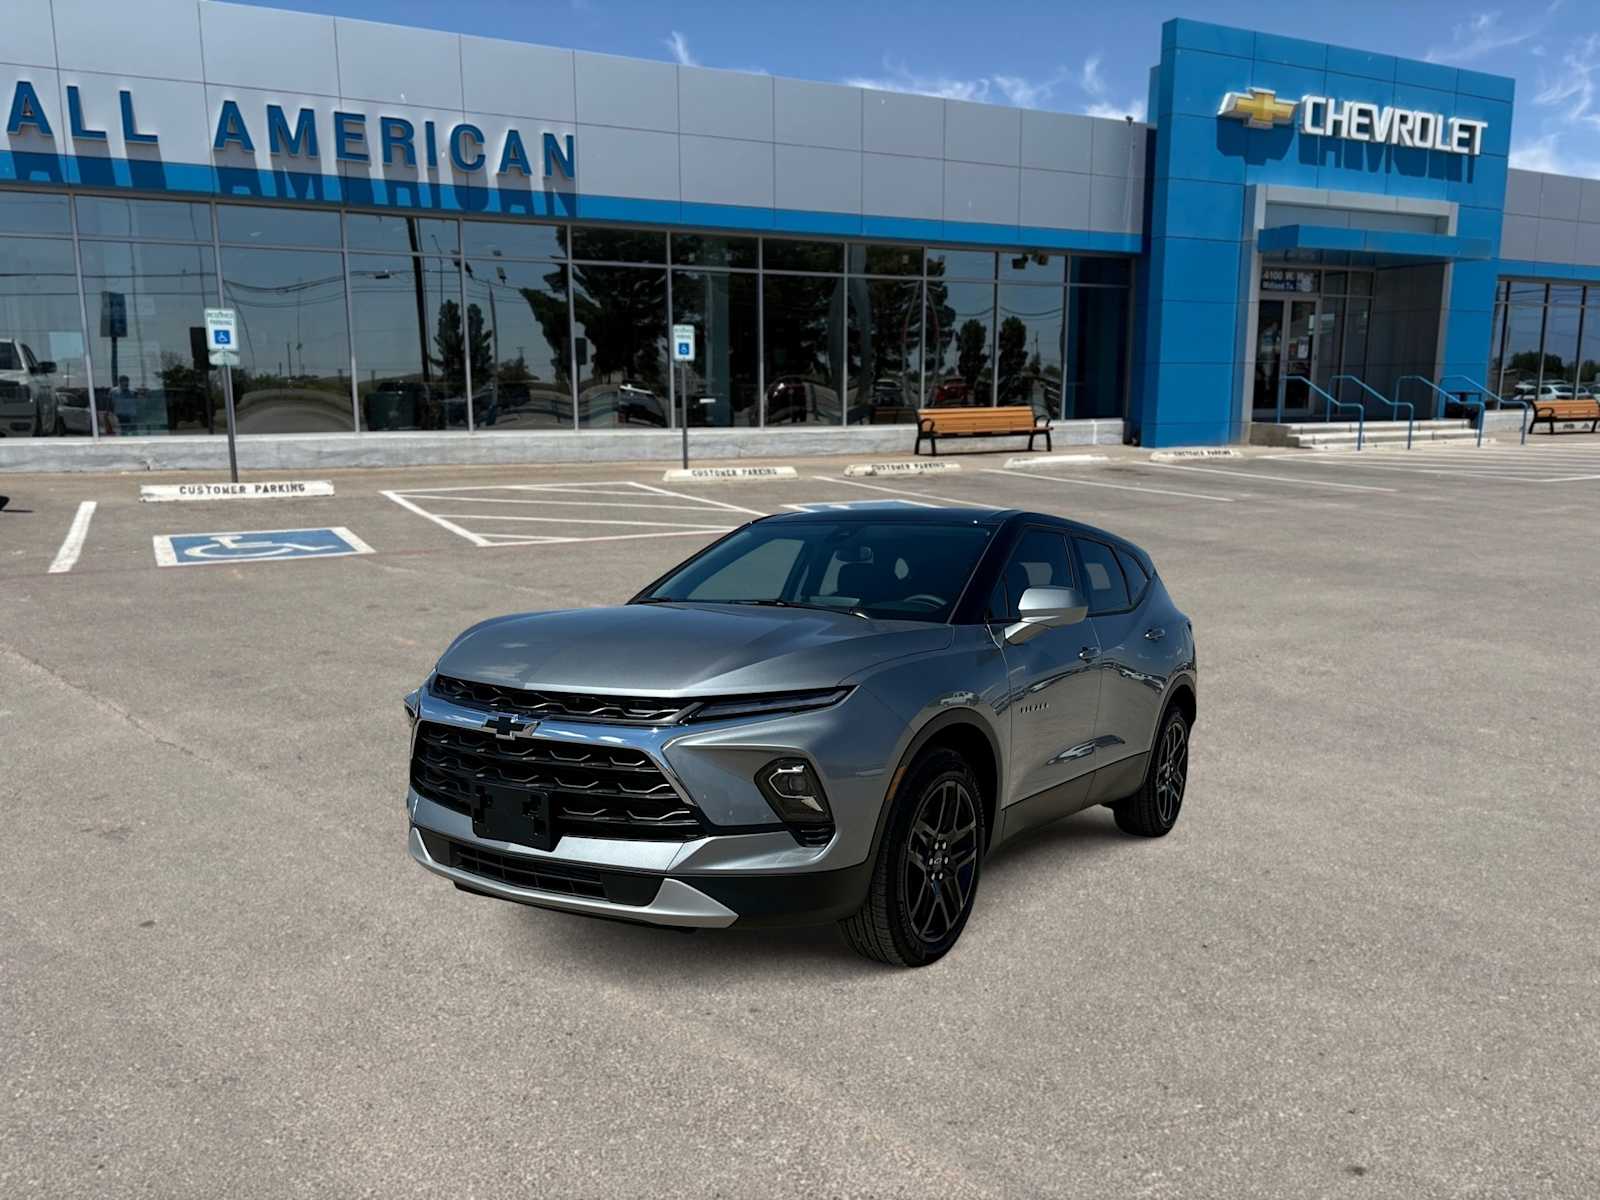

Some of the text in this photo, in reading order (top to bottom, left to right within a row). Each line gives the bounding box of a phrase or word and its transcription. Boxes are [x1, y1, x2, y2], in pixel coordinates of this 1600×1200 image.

[6, 81, 576, 178] ALL AMERICAN
[1302, 94, 1488, 155] CHEVROLET
[179, 483, 306, 495] CUSTOMER PARKING
[691, 468, 777, 477] CUSTOMER PARKING
